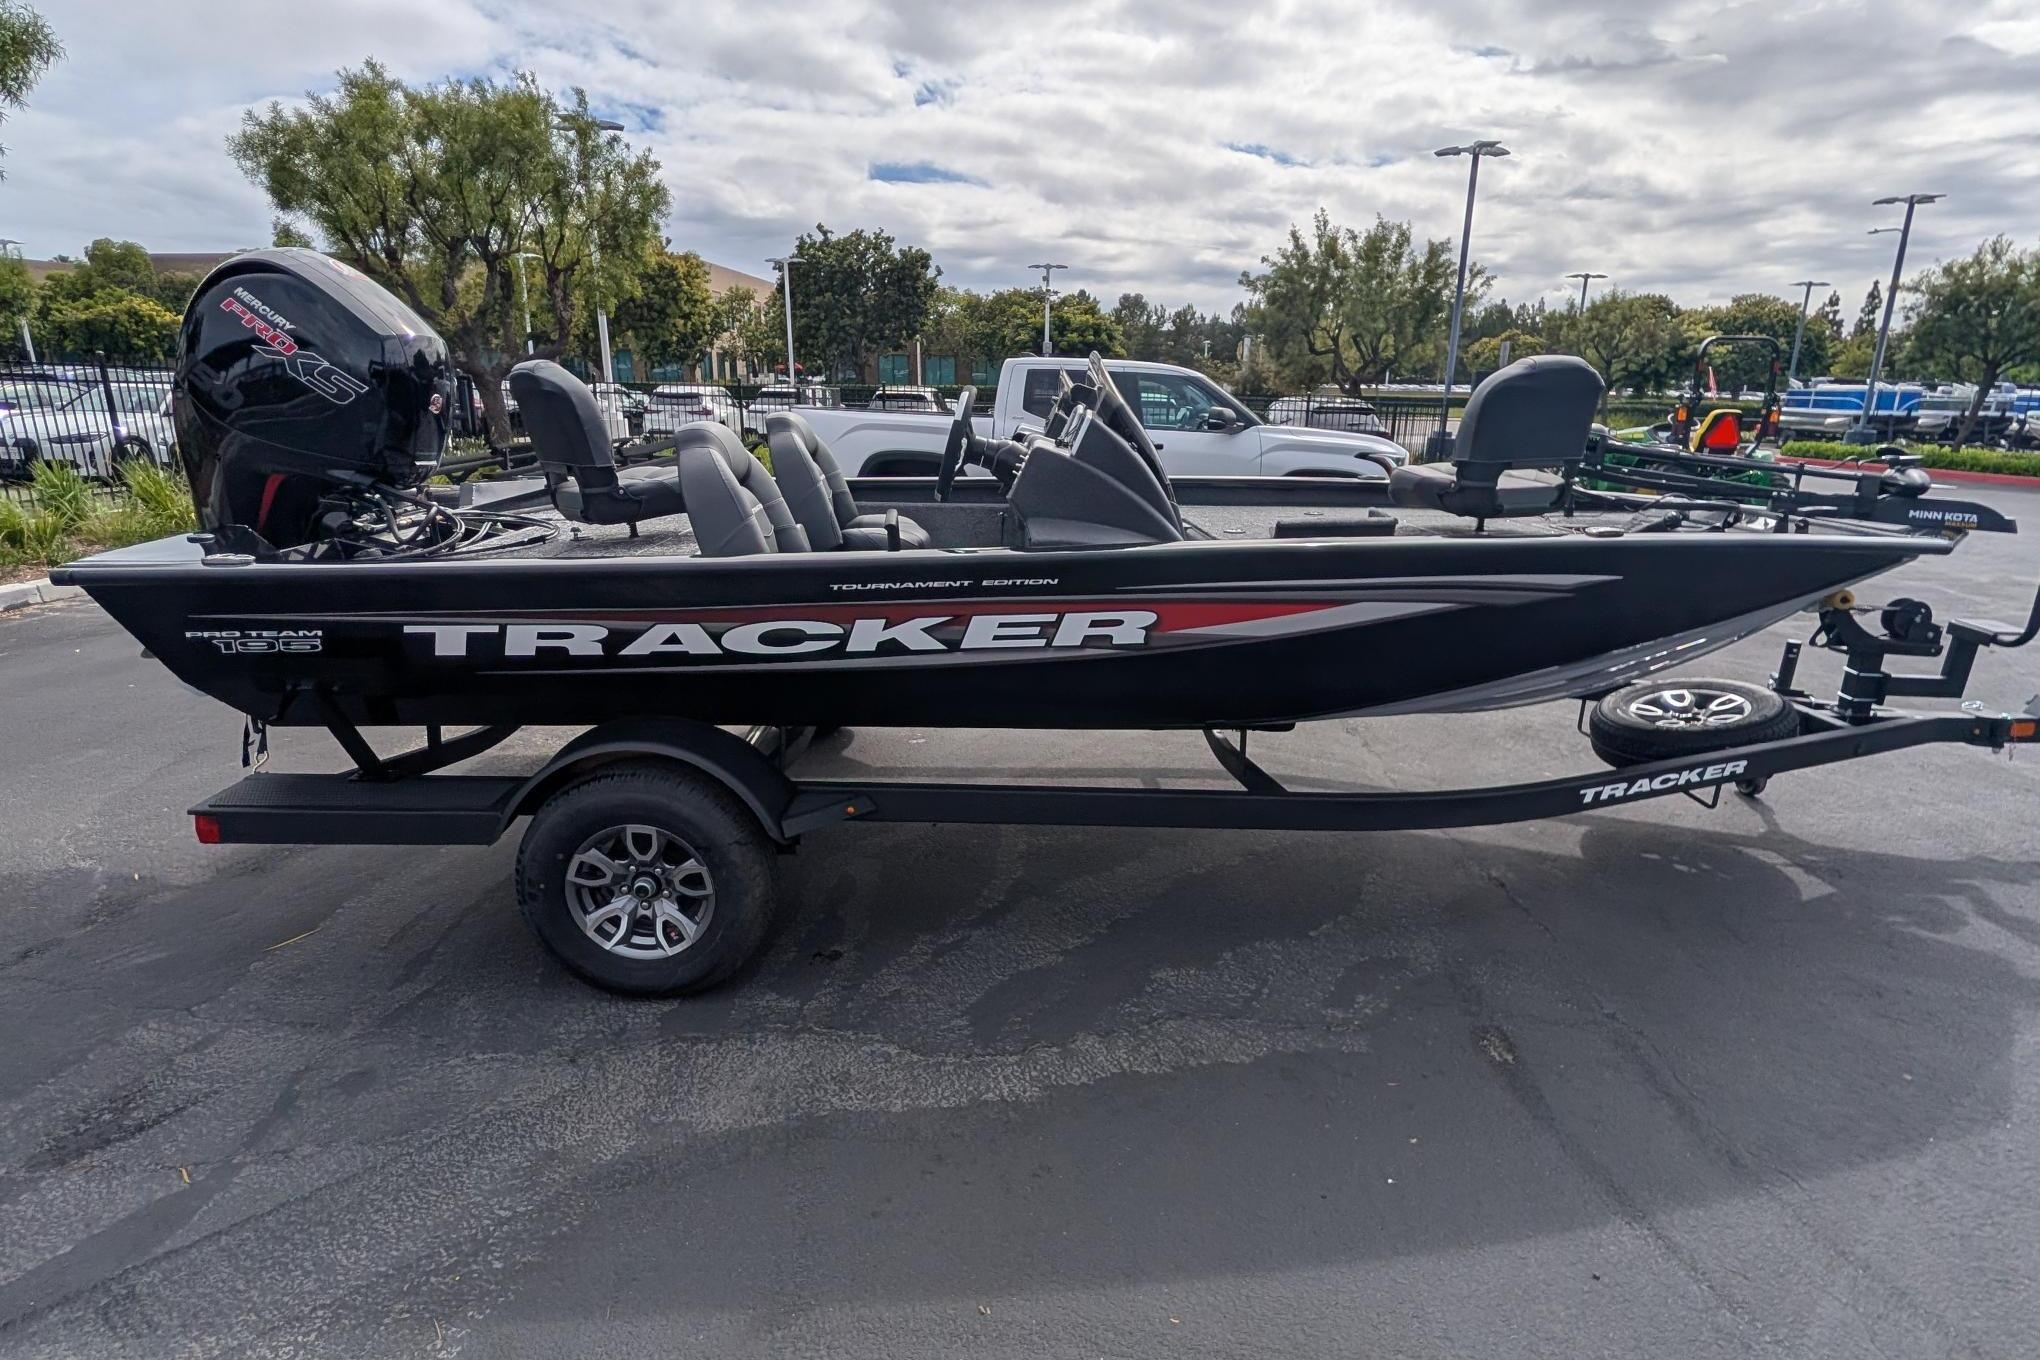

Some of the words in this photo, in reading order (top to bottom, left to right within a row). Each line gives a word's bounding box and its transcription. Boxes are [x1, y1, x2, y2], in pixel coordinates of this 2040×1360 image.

[220, 298, 299, 356] PRO
[234, 287, 297, 331] MERCURY
[251, 344, 370, 405] XS
[1908, 510, 1942, 520] MINN
[1944, 512, 1978, 522] KOTA
[829, 580, 973, 591] TOURNAMENT
[981, 578, 1059, 586] EDITION
[211, 638, 322, 653] 195
[402, 610, 1158, 656] TRACKER
[1579, 759, 1748, 804] TRACKER
